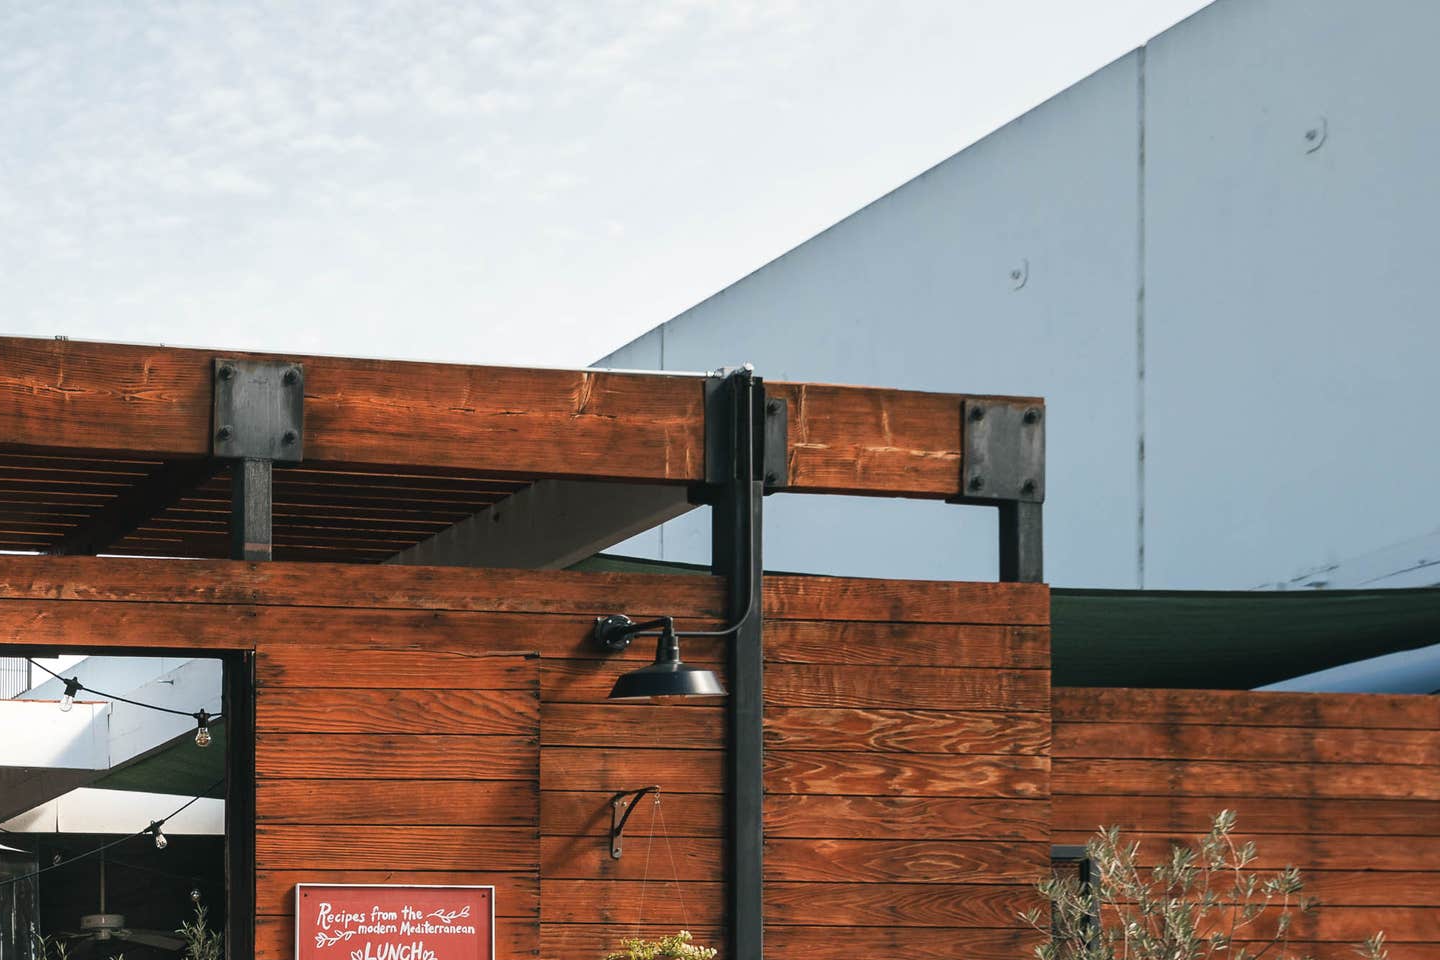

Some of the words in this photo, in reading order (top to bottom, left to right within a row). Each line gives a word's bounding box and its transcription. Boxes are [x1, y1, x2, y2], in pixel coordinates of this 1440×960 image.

[317, 902, 366, 930] Recipes
[371, 906, 397, 922] from
[402, 905, 423, 920] the
[358, 922, 397, 935] modern
[400, 921, 476, 936] Mediterranean
